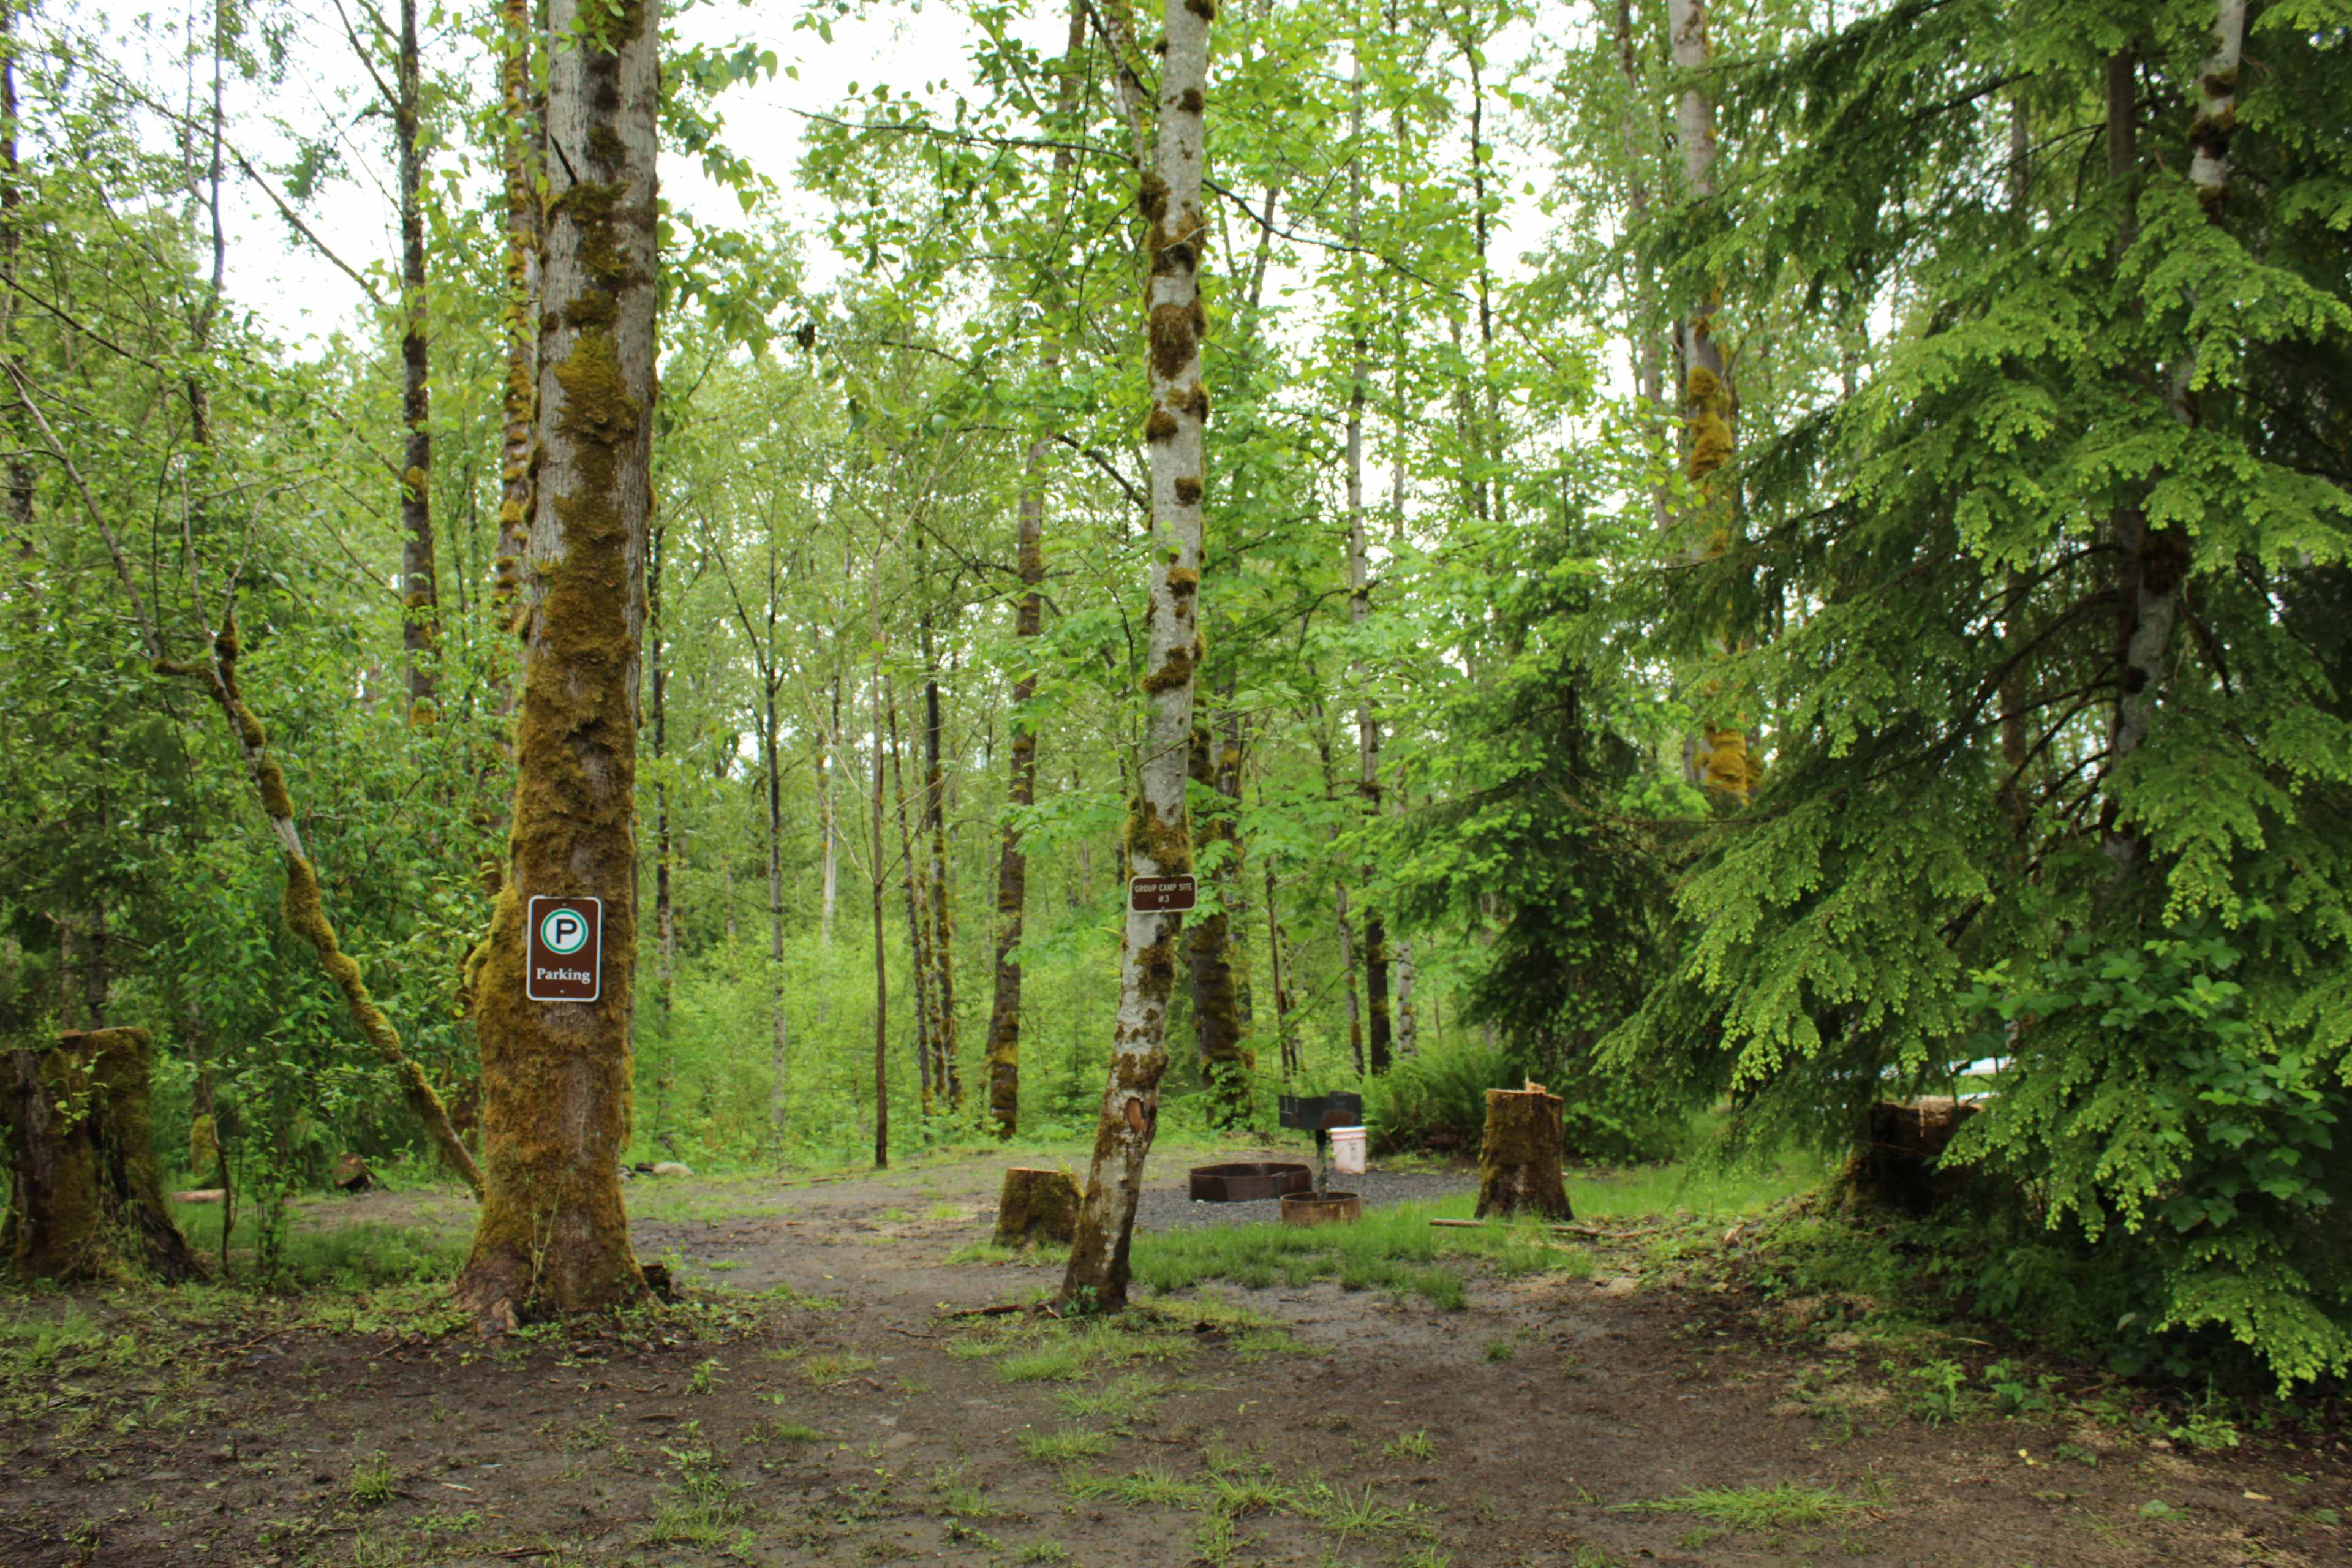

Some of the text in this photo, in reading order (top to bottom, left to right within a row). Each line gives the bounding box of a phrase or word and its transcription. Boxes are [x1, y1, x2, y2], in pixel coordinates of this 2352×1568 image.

[1178, 883, 1192, 891] SITE
[556, 919, 578, 944] P
[536, 968, 590, 984] Parking
